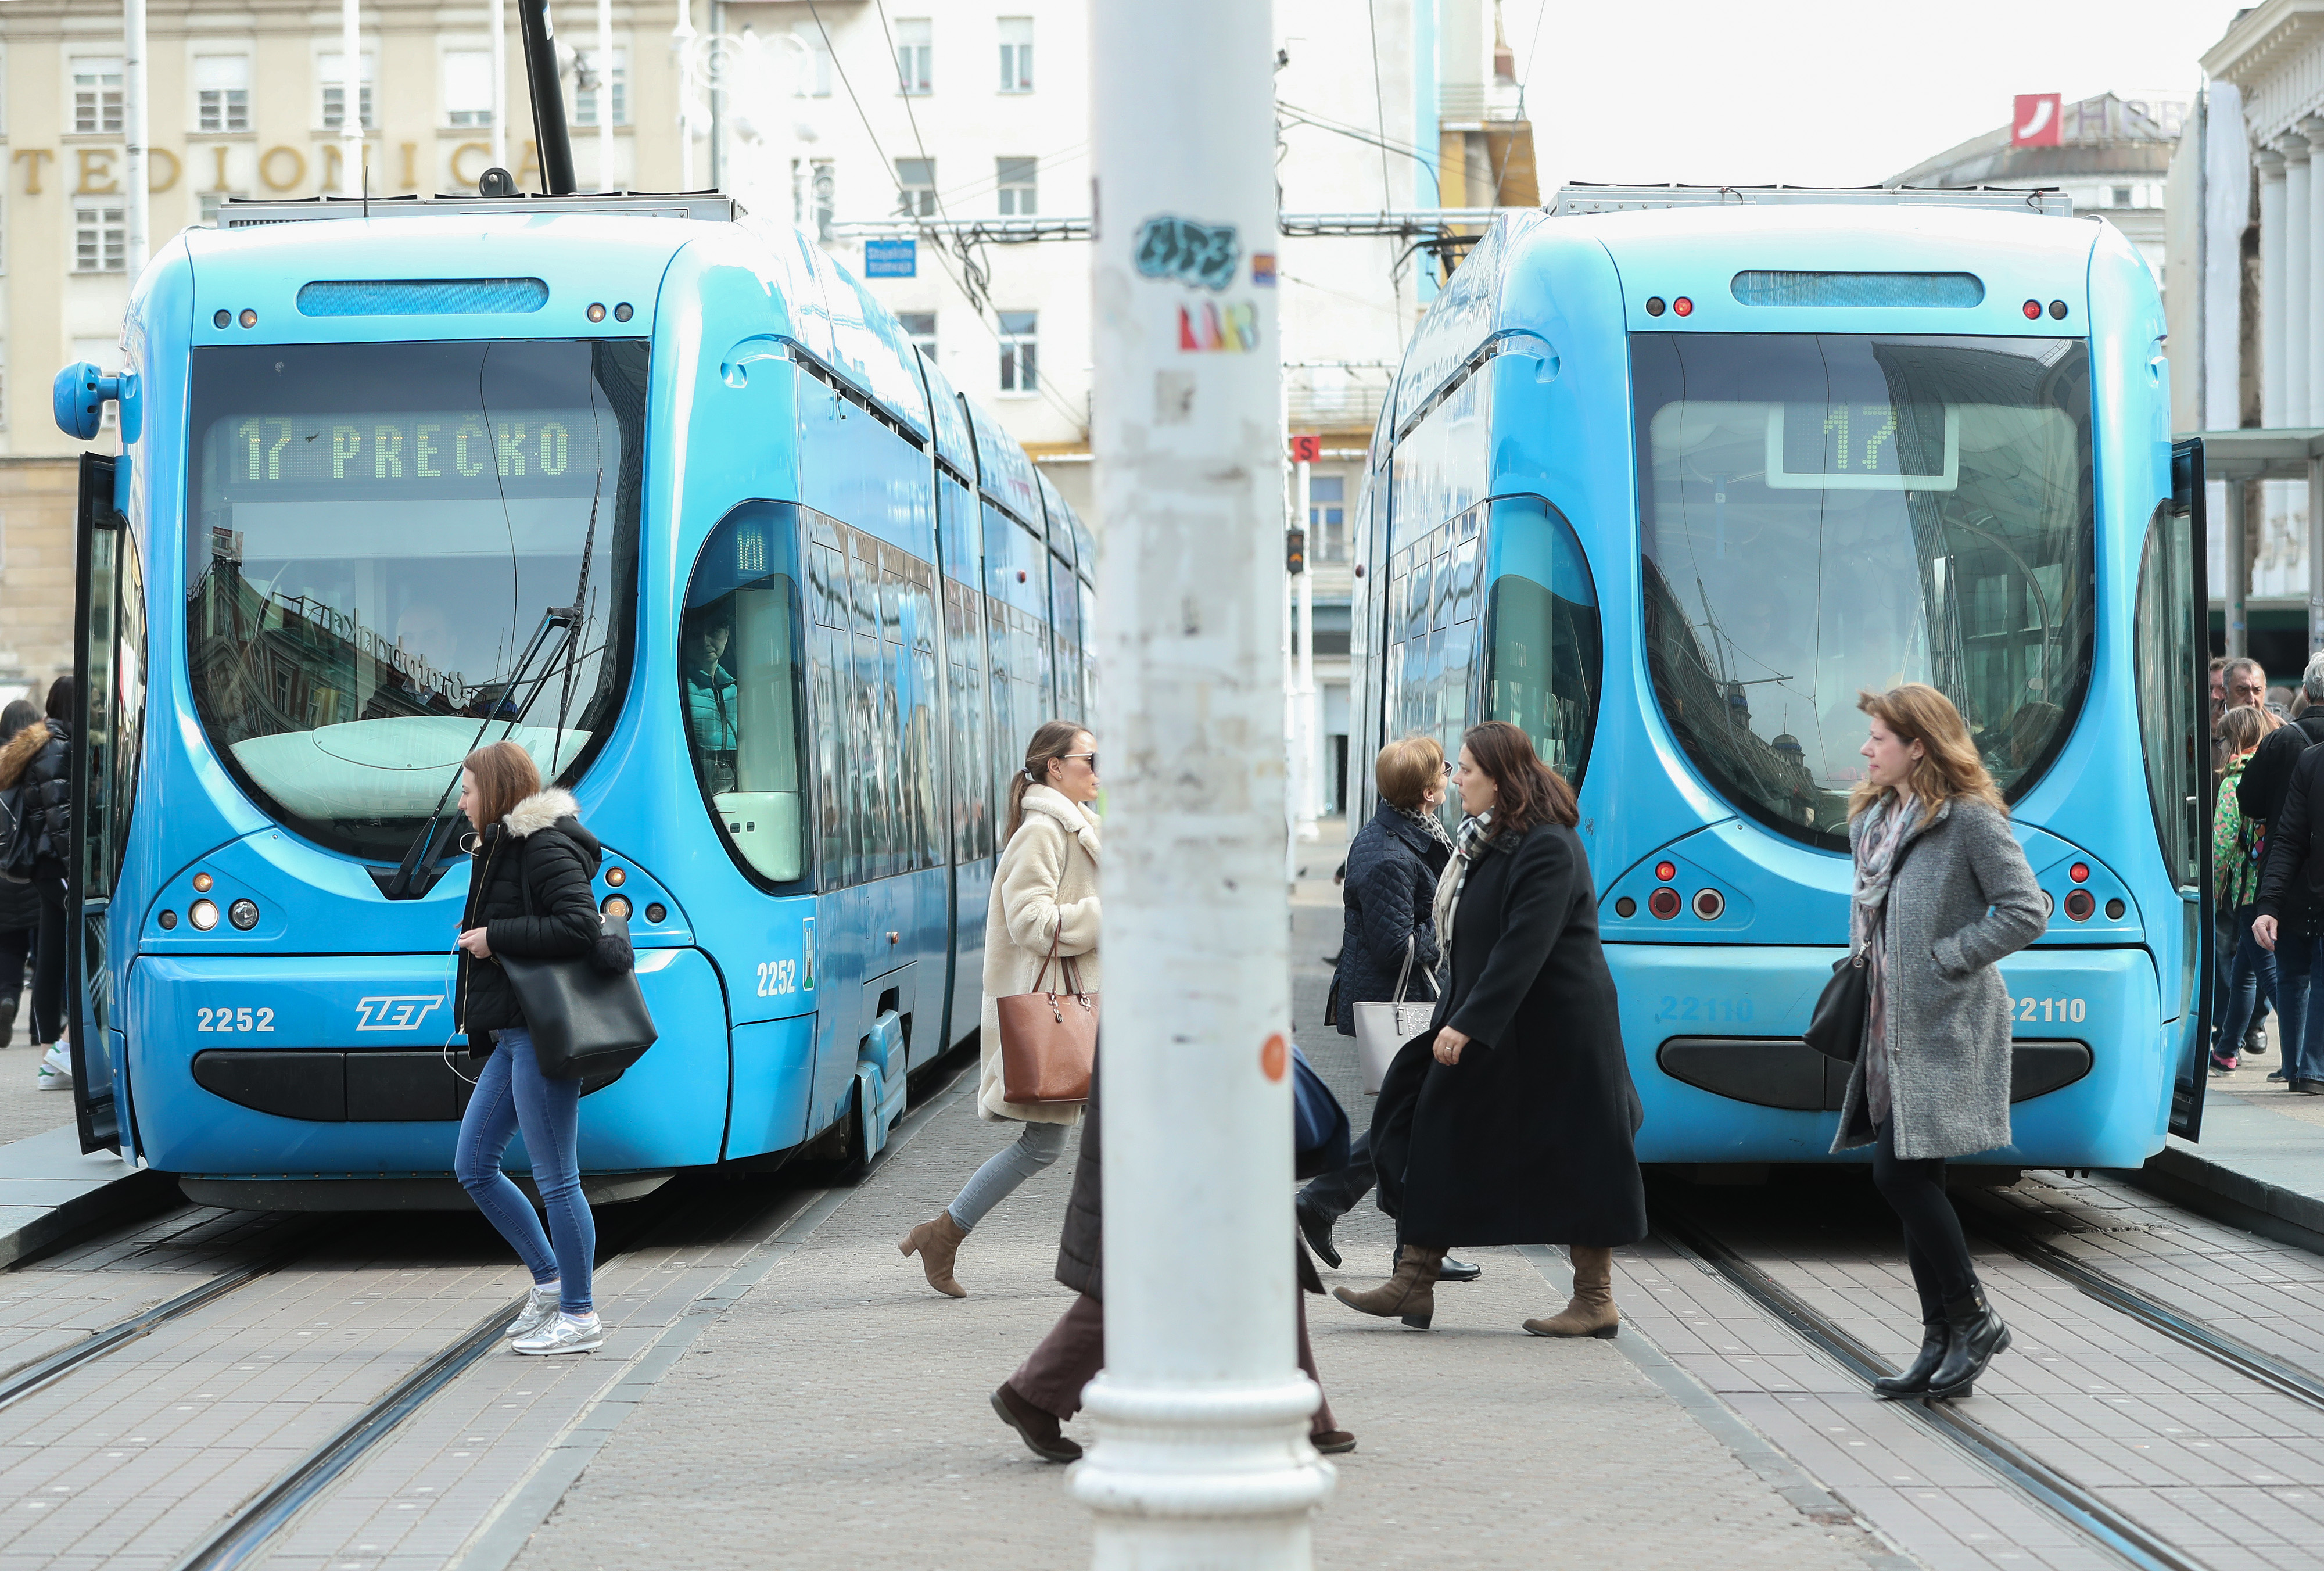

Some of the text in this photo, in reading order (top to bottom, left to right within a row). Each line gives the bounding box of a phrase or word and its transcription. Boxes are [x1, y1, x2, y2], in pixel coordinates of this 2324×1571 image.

[239, 414, 568, 480] 17 PREČKO
[1300, 438, 1312, 460] S
[1823, 406, 1898, 470] 17
[757, 959, 796, 997] 2252
[196, 1007, 275, 1032] 2252
[355, 995, 446, 1031] ZET
